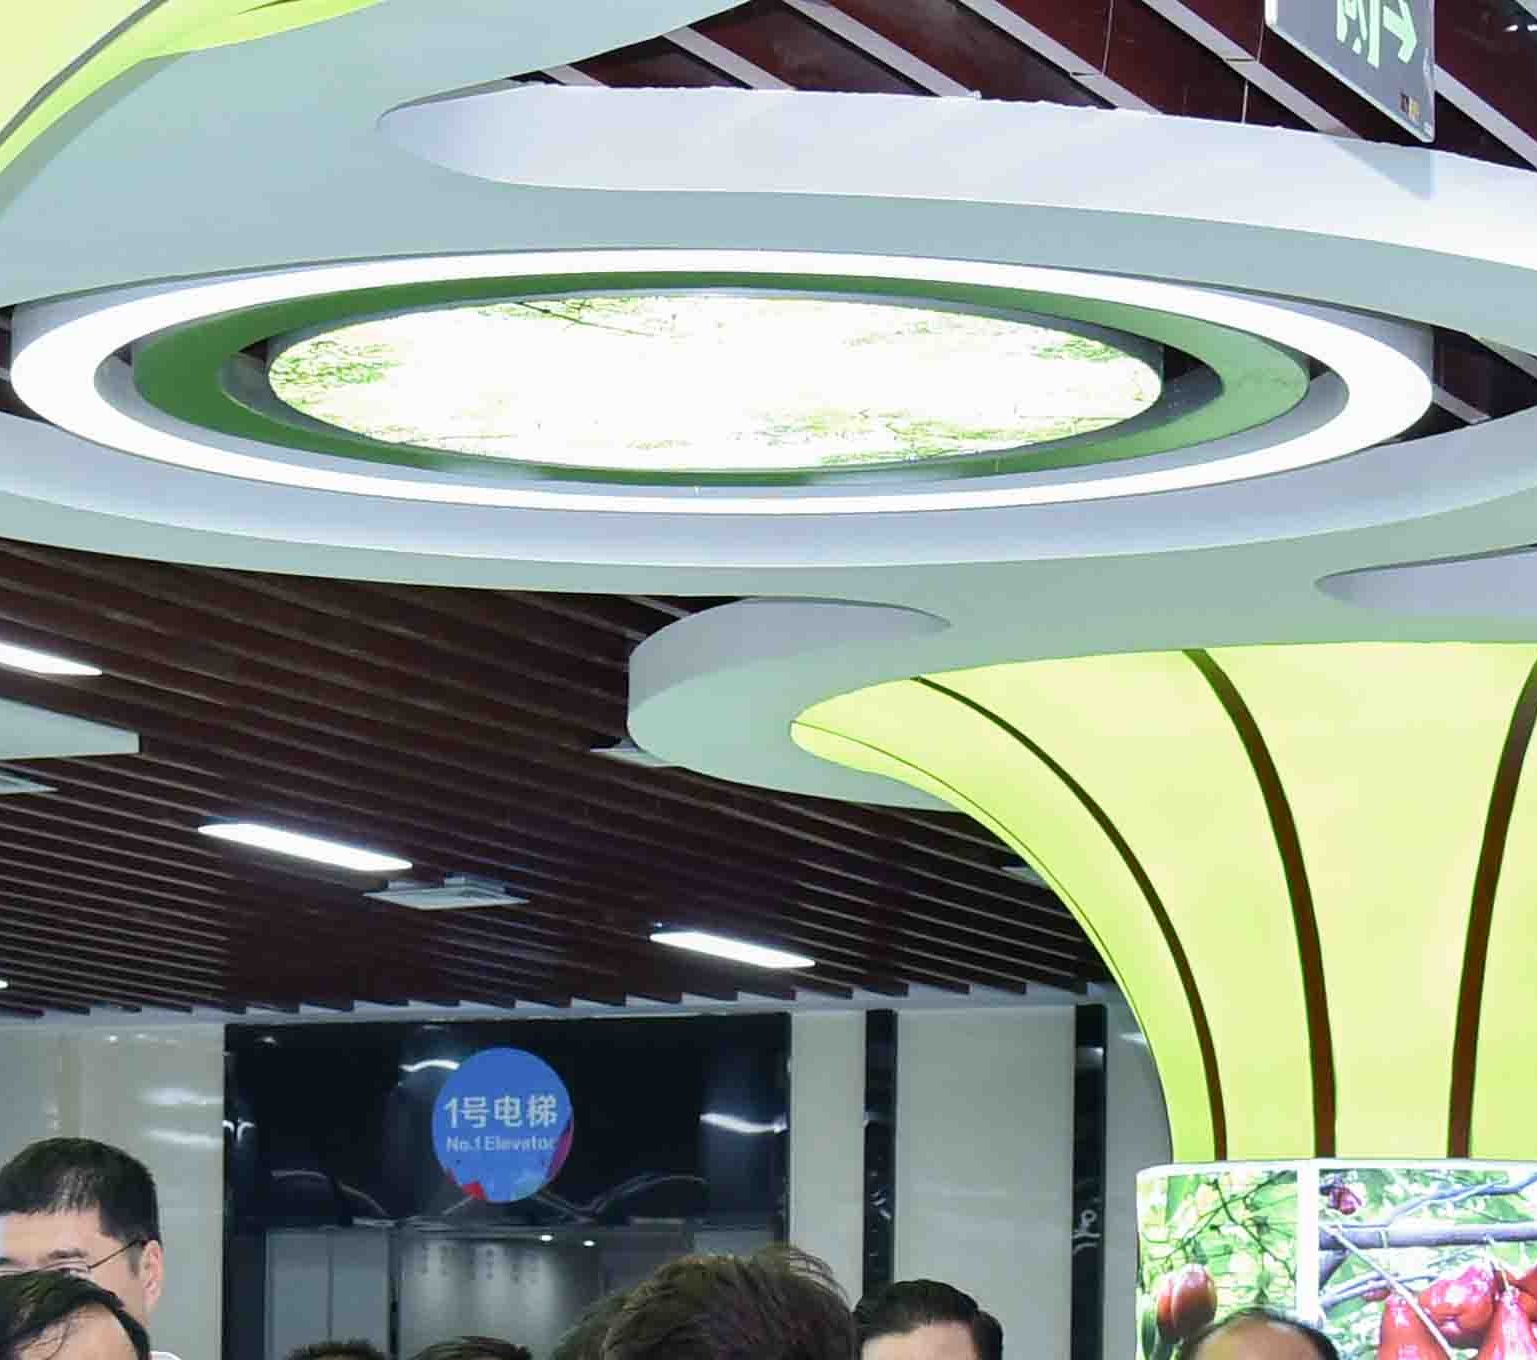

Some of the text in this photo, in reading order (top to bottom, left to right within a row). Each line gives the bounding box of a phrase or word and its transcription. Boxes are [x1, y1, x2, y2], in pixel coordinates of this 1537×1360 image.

[443, 1093, 559, 1128] 1号电梯
[485, 1136, 558, 1152] Elevator
